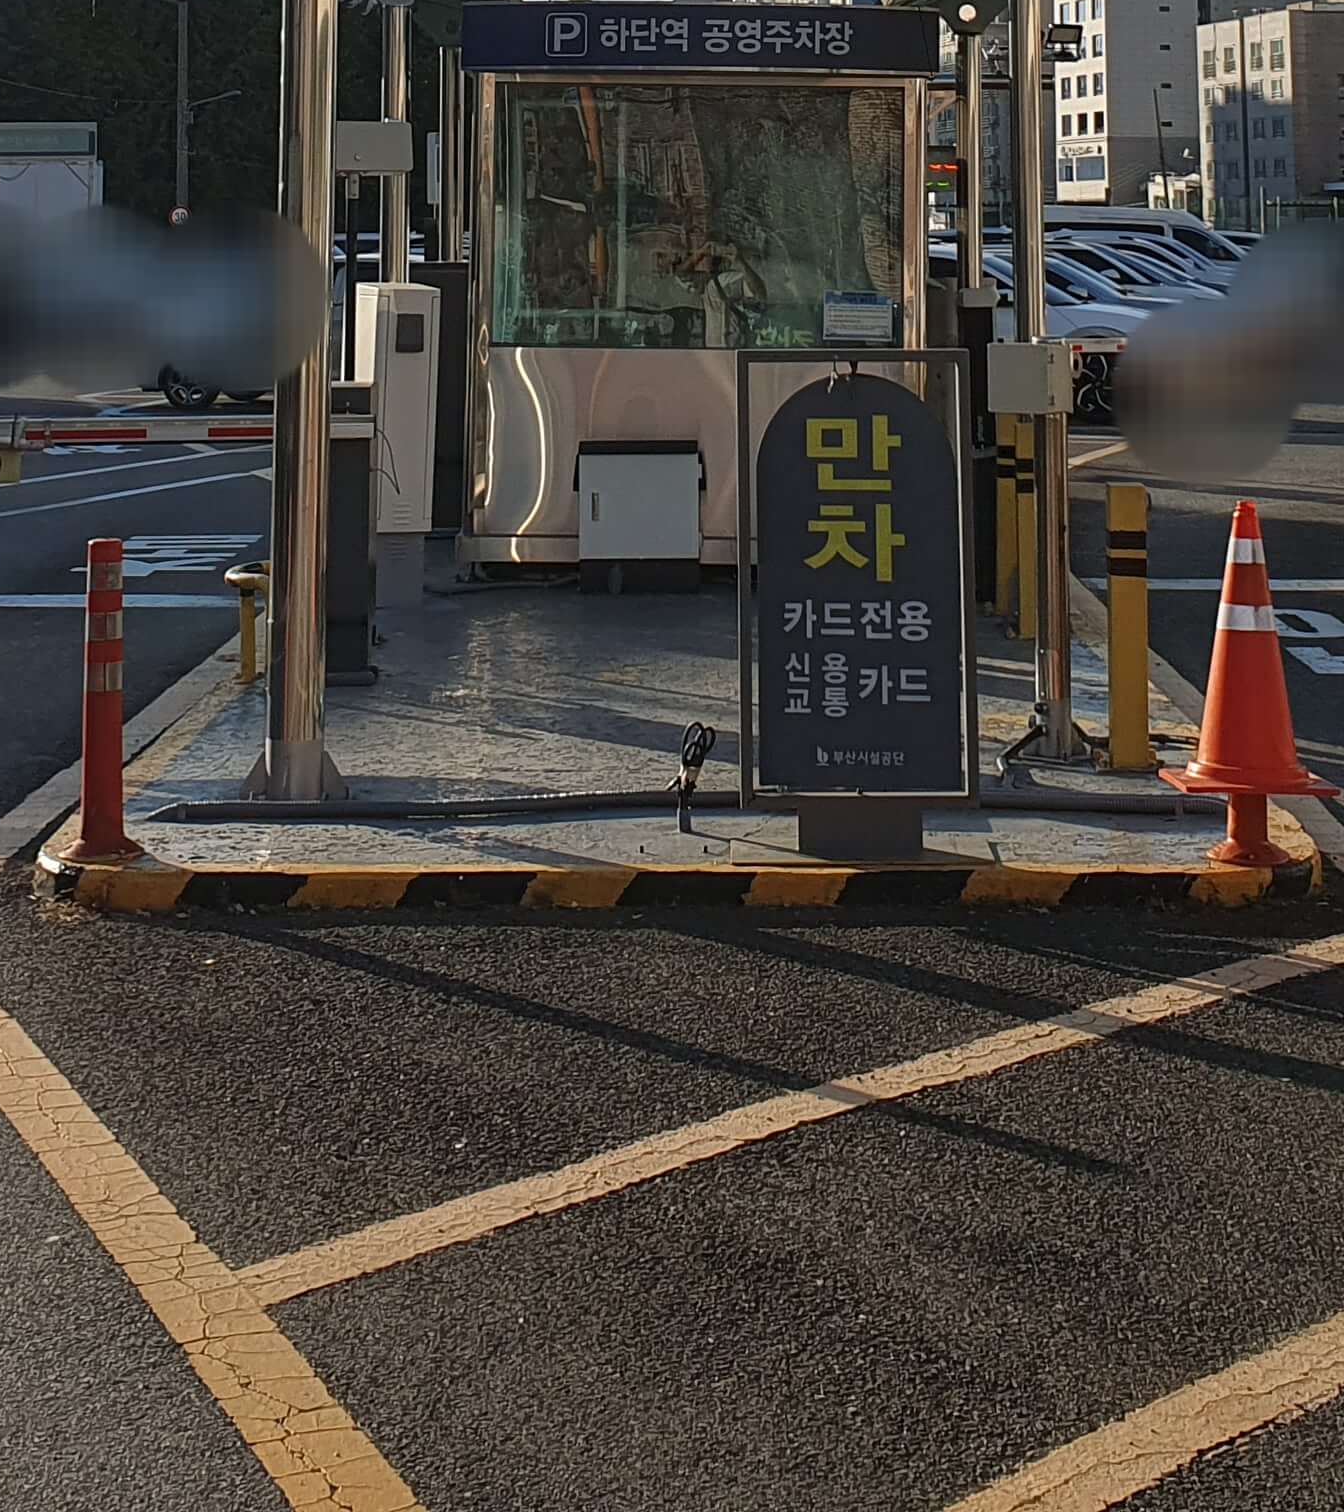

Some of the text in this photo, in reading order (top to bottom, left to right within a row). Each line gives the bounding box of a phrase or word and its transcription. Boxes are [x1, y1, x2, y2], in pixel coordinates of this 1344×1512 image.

[599, 16, 690, 54] 하단역
[701, 18, 853, 56] 공영주차장
[805, 414, 906, 582] 만차
[783, 599, 934, 643] 카드전용
[784, 651, 851, 684] 신용
[857, 664, 933, 706] 카드
[783, 686, 851, 718] 교통
[832, 750, 905, 767] 부산시설공단
